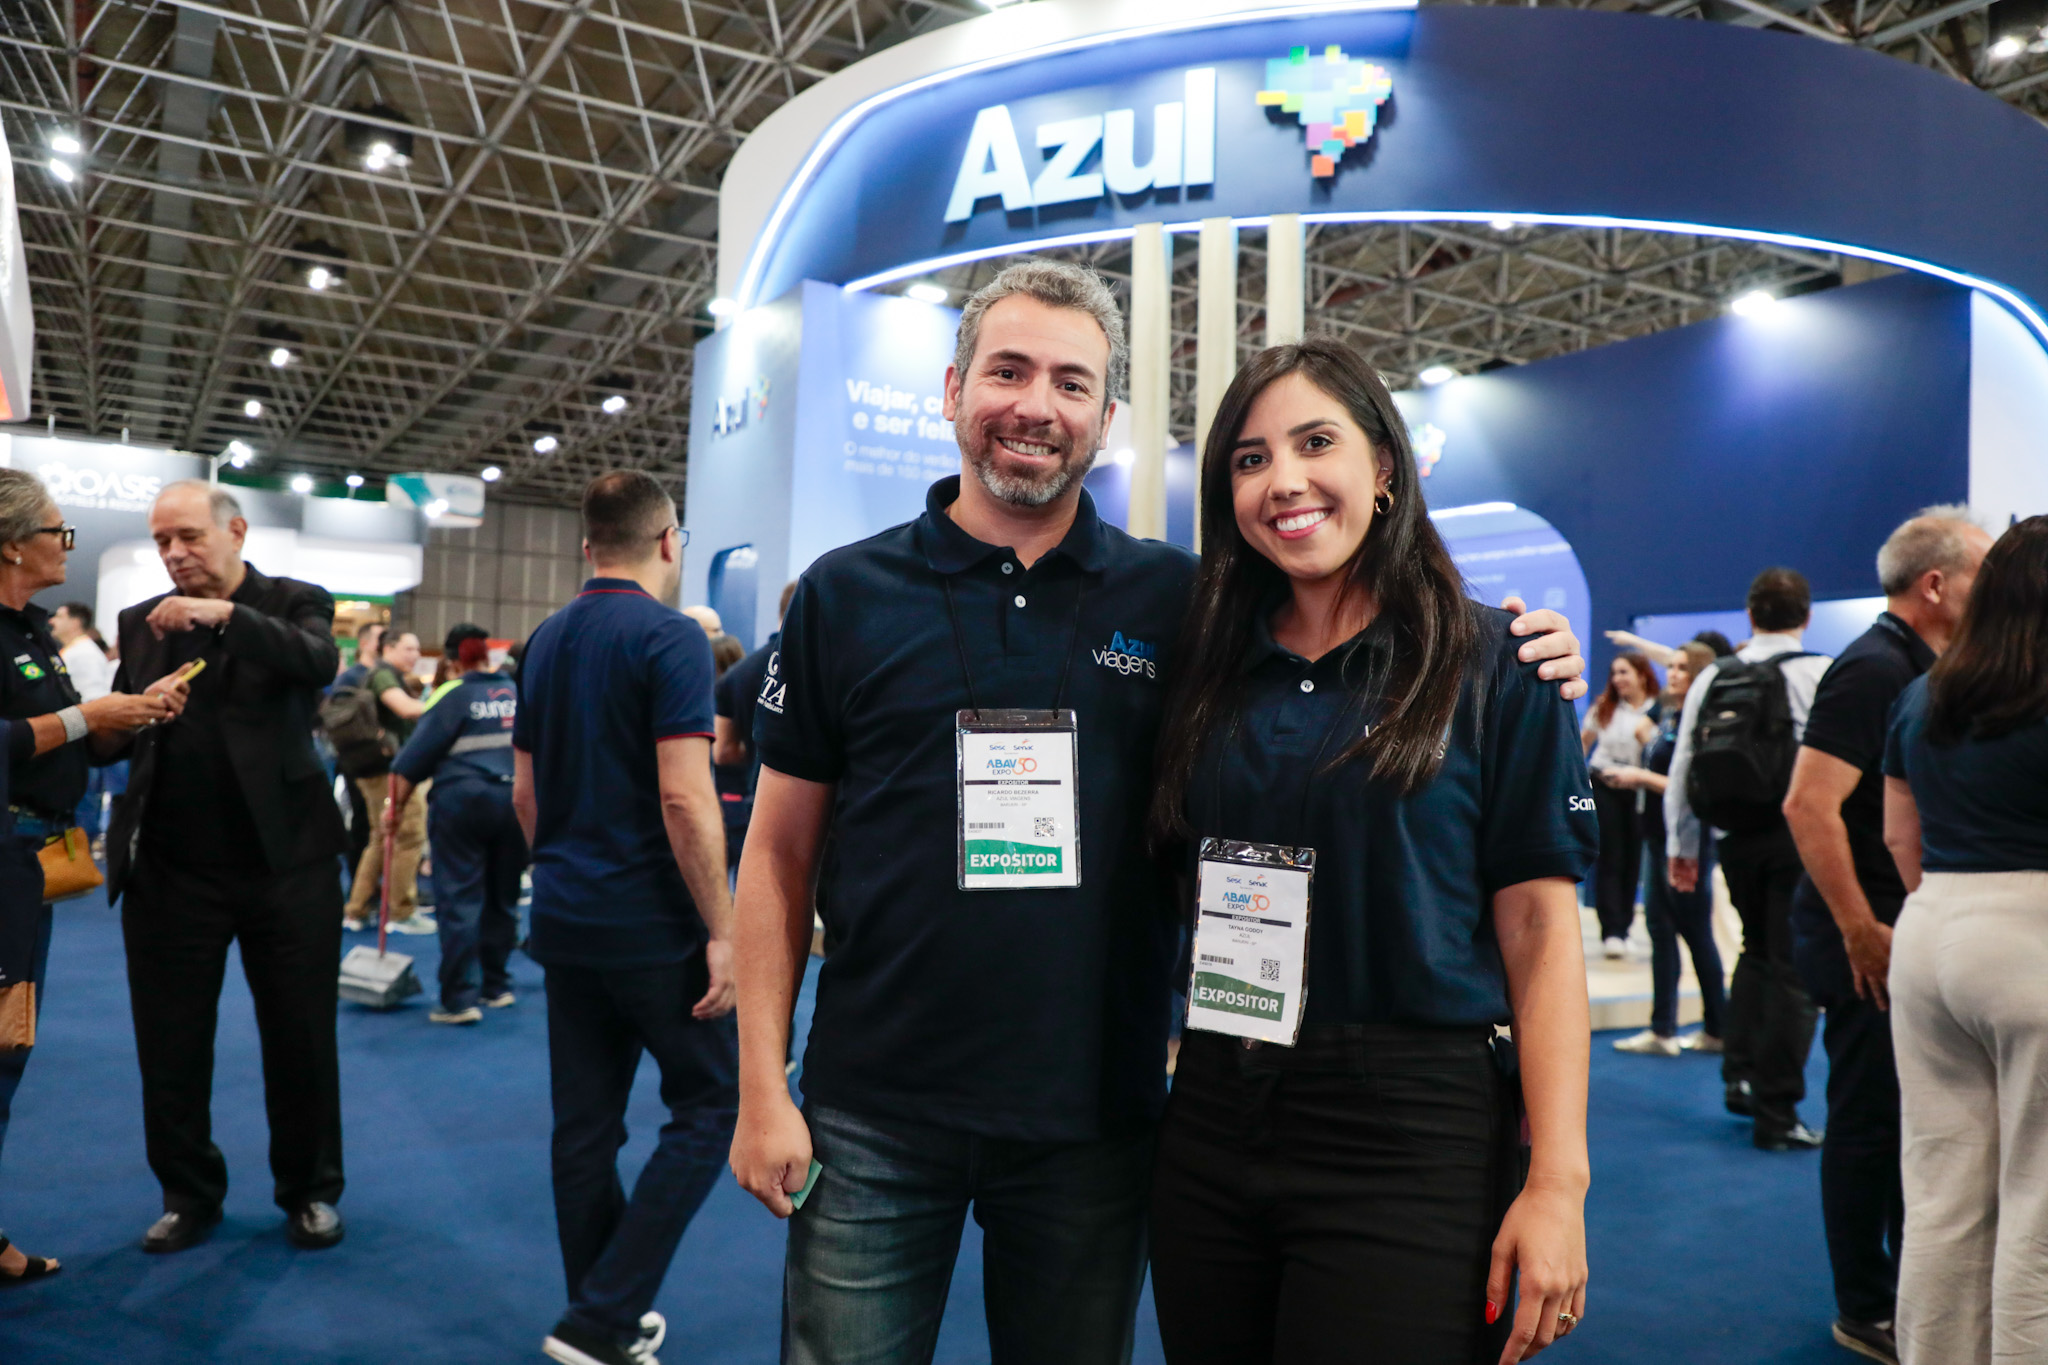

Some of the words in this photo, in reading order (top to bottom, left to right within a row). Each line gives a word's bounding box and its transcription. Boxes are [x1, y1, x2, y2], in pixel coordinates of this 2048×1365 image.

[944, 67, 1216, 223] Azul
[846, 378, 918, 415] Viajar,
[853, 411, 869, 430] e
[874, 414, 914, 436] ser
[1092, 644, 1156, 679] viagens
[986, 758, 1017, 769] ABAV
[970, 853, 1058, 867] EXPOSITOR
[1222, 891, 1252, 904] ABAV
[1227, 902, 1246, 911] EXPO
[1245, 926, 1264, 934] GODOY
[1198, 986, 1279, 1013] EXPOSITOR
